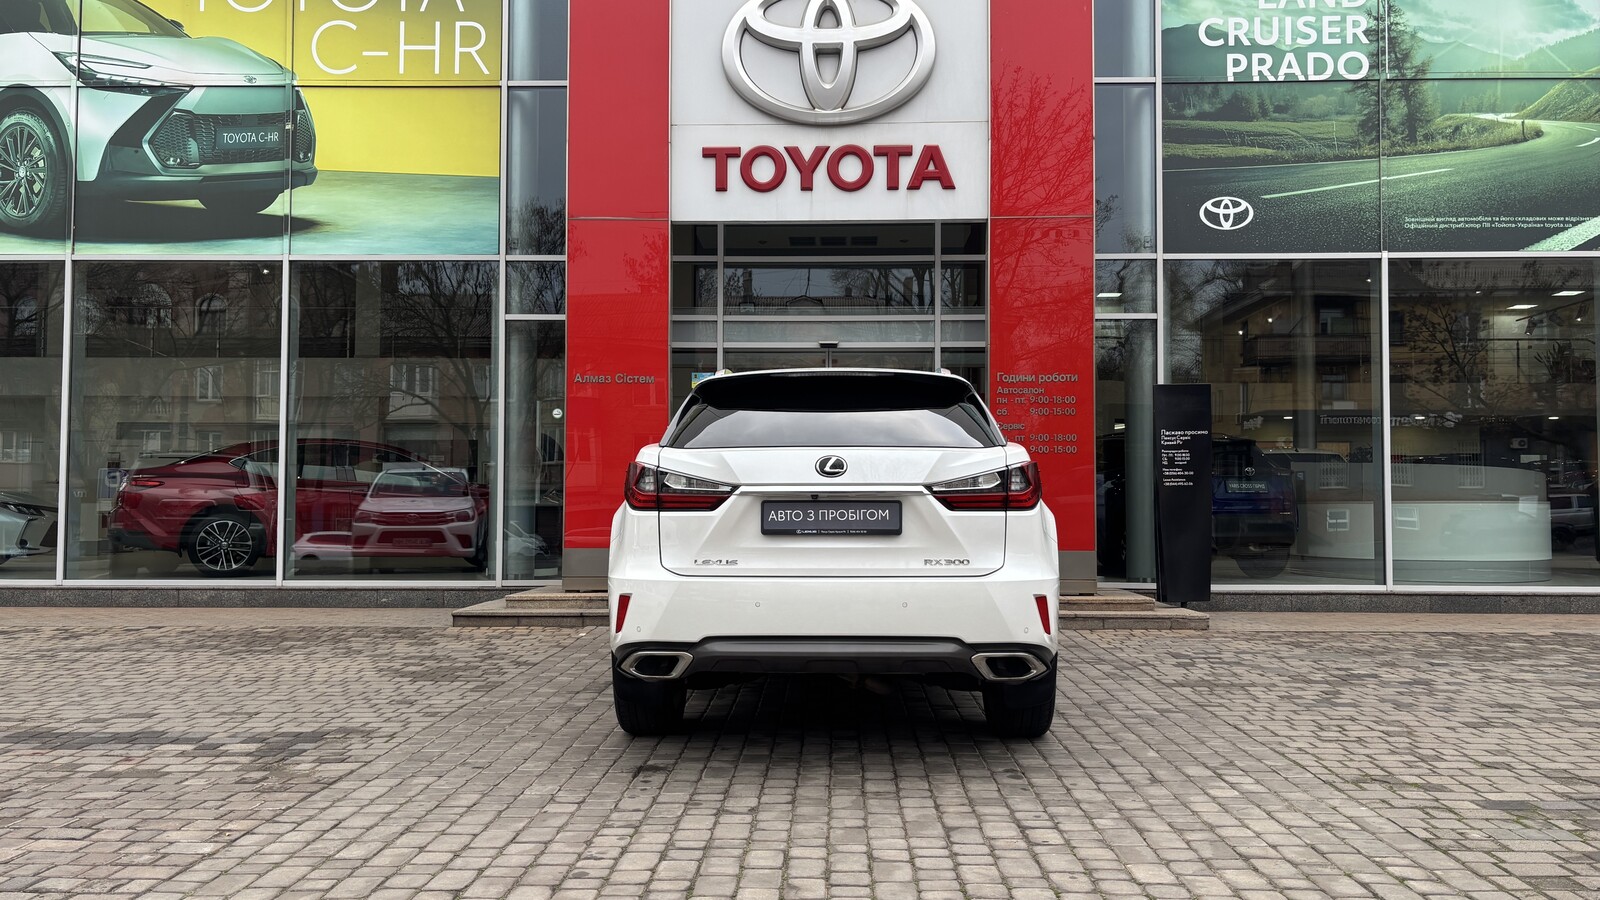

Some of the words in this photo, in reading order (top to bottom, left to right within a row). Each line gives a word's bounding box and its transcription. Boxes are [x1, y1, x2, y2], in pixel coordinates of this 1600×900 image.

[1198, 15, 1370, 47] CRUISER
[311, 20, 490, 75] C-HR
[1226, 51, 1370, 82] PRADO
[223, 133, 257, 144] TOYOTA
[259, 132, 279, 142] C-HR
[702, 144, 956, 193] TOYOTA
[574, 373, 612, 383] Алмаз
[615, 373, 655, 384] Сістем
[996, 372, 1036, 383] Години
[1039, 372, 1078, 384] роботи
[996, 386, 1045, 394] Автосалон
[998, 421, 1025, 431] Сервіс
[768, 510, 803, 522] АВТО
[819, 509, 890, 521] ПРОБІГОМ
